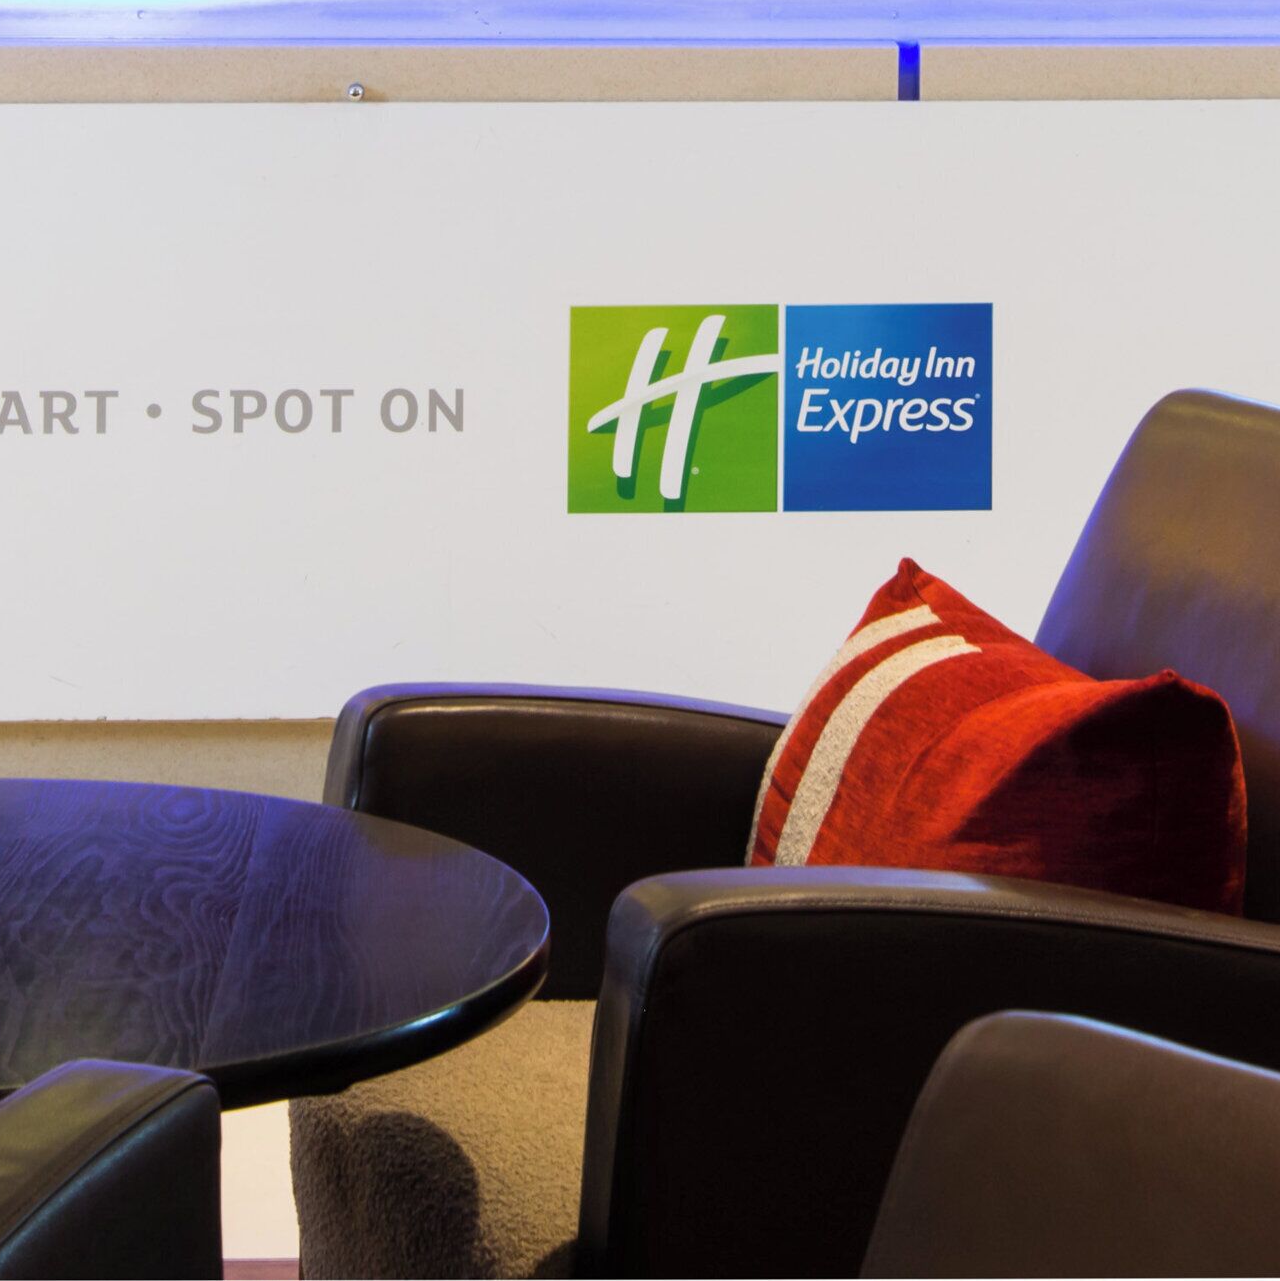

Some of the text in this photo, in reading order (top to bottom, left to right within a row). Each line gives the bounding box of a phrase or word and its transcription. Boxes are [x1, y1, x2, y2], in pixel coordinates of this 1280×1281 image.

[796, 346, 976, 386] Holiday Inn
[190, 387, 356, 436] SPOT
[378, 386, 466, 435] ON
[796, 388, 975, 445] Express
